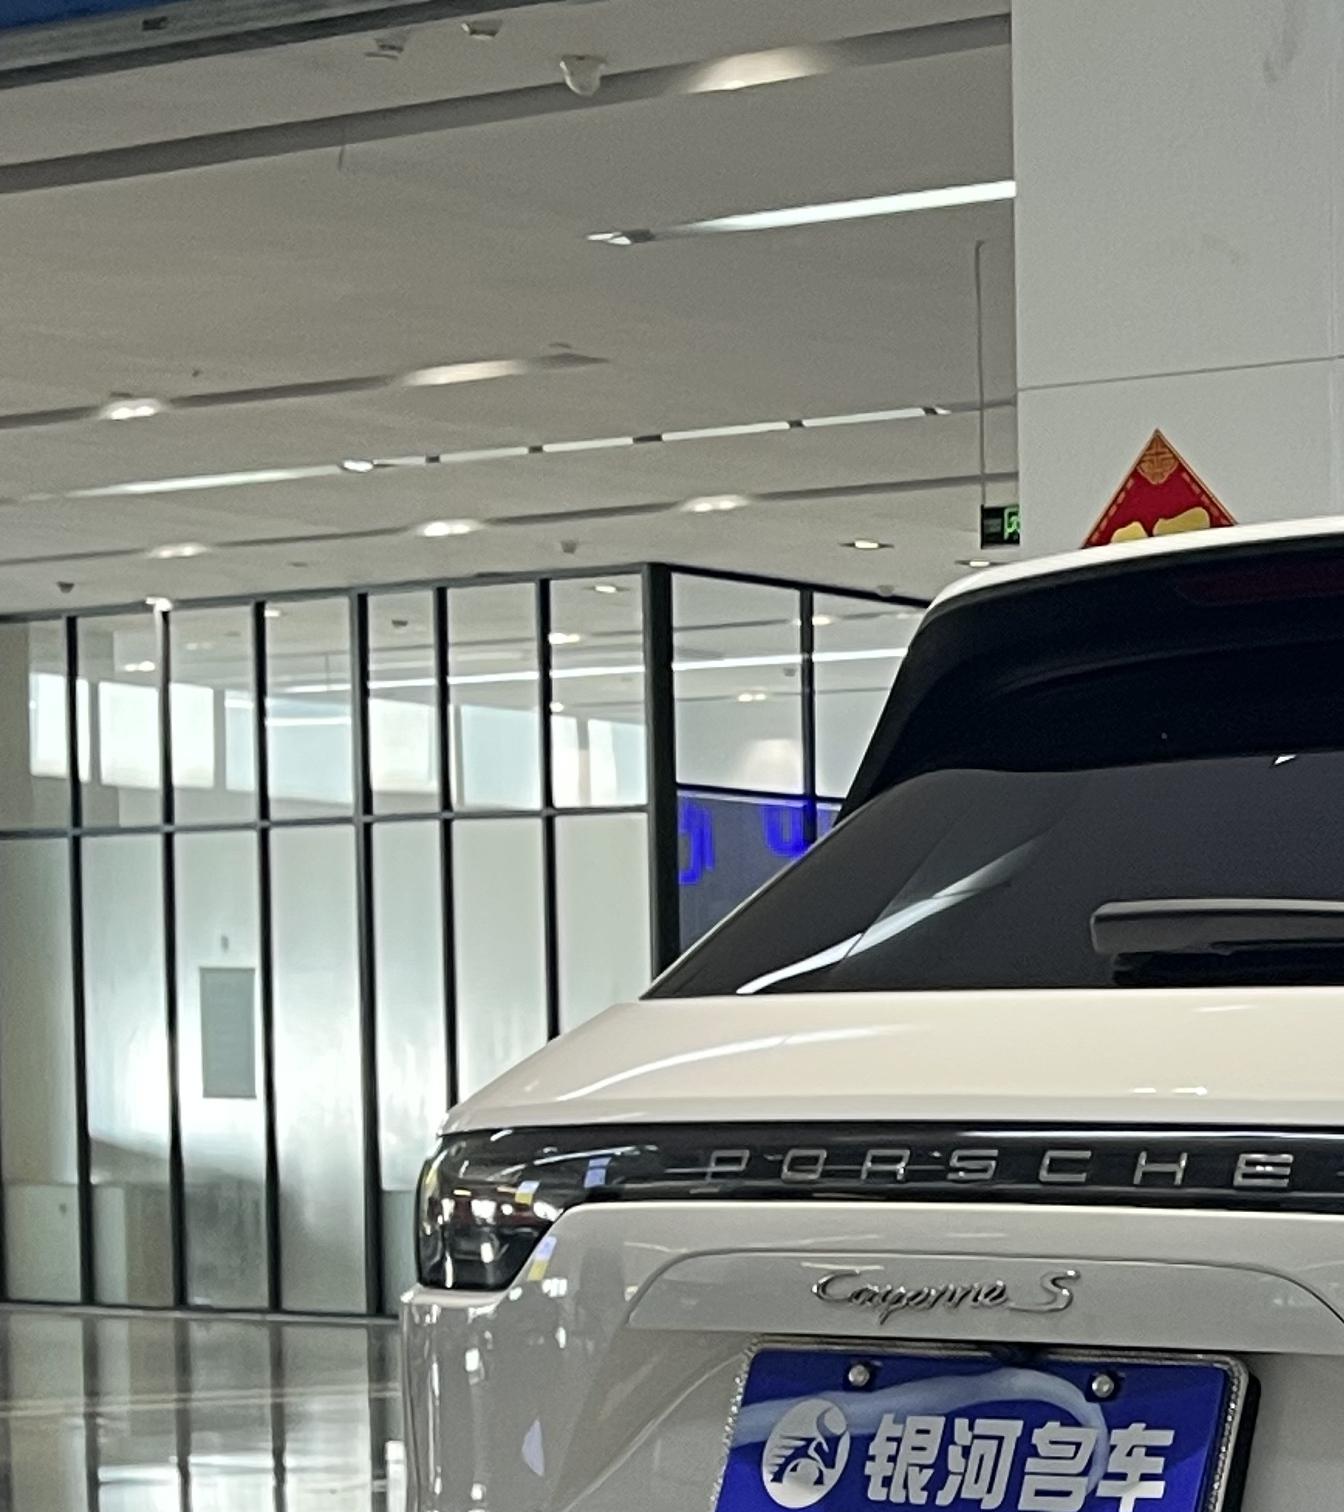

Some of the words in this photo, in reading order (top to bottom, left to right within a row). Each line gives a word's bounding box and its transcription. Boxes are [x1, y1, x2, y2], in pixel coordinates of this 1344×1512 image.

[706, 1148, 1294, 1188] PORSCHE
[811, 1270, 1007, 1325] Cayenne
[1004, 1269, 1080, 1313] S
